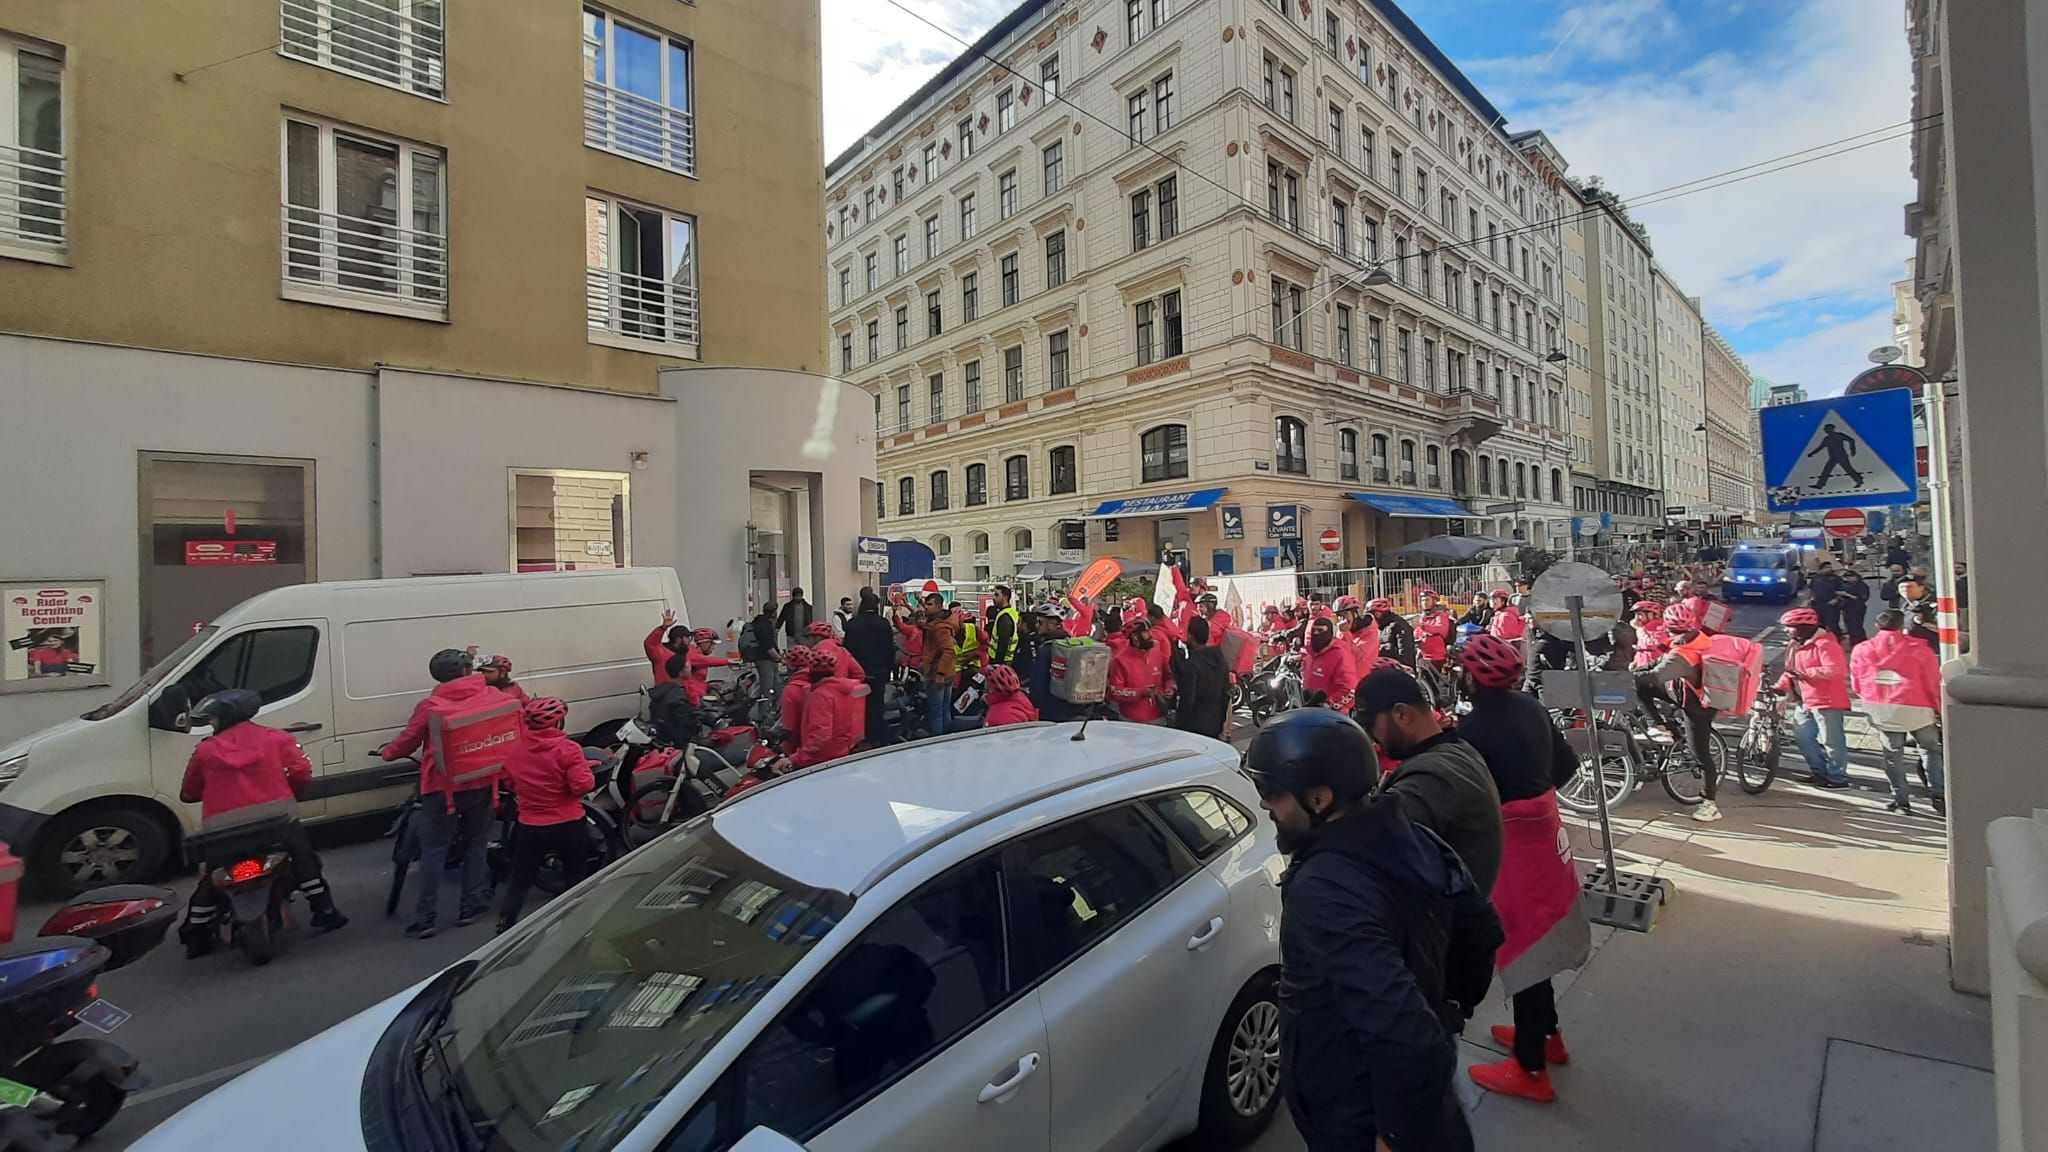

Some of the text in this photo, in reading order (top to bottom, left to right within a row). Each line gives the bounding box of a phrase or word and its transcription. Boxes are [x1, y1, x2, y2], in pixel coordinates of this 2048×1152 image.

[1121, 493, 1195, 507] RESTAURANT
[37, 598, 69, 607] Rider
[22, 606, 84, 617] Recruiting
[33, 616, 73, 625] Center
